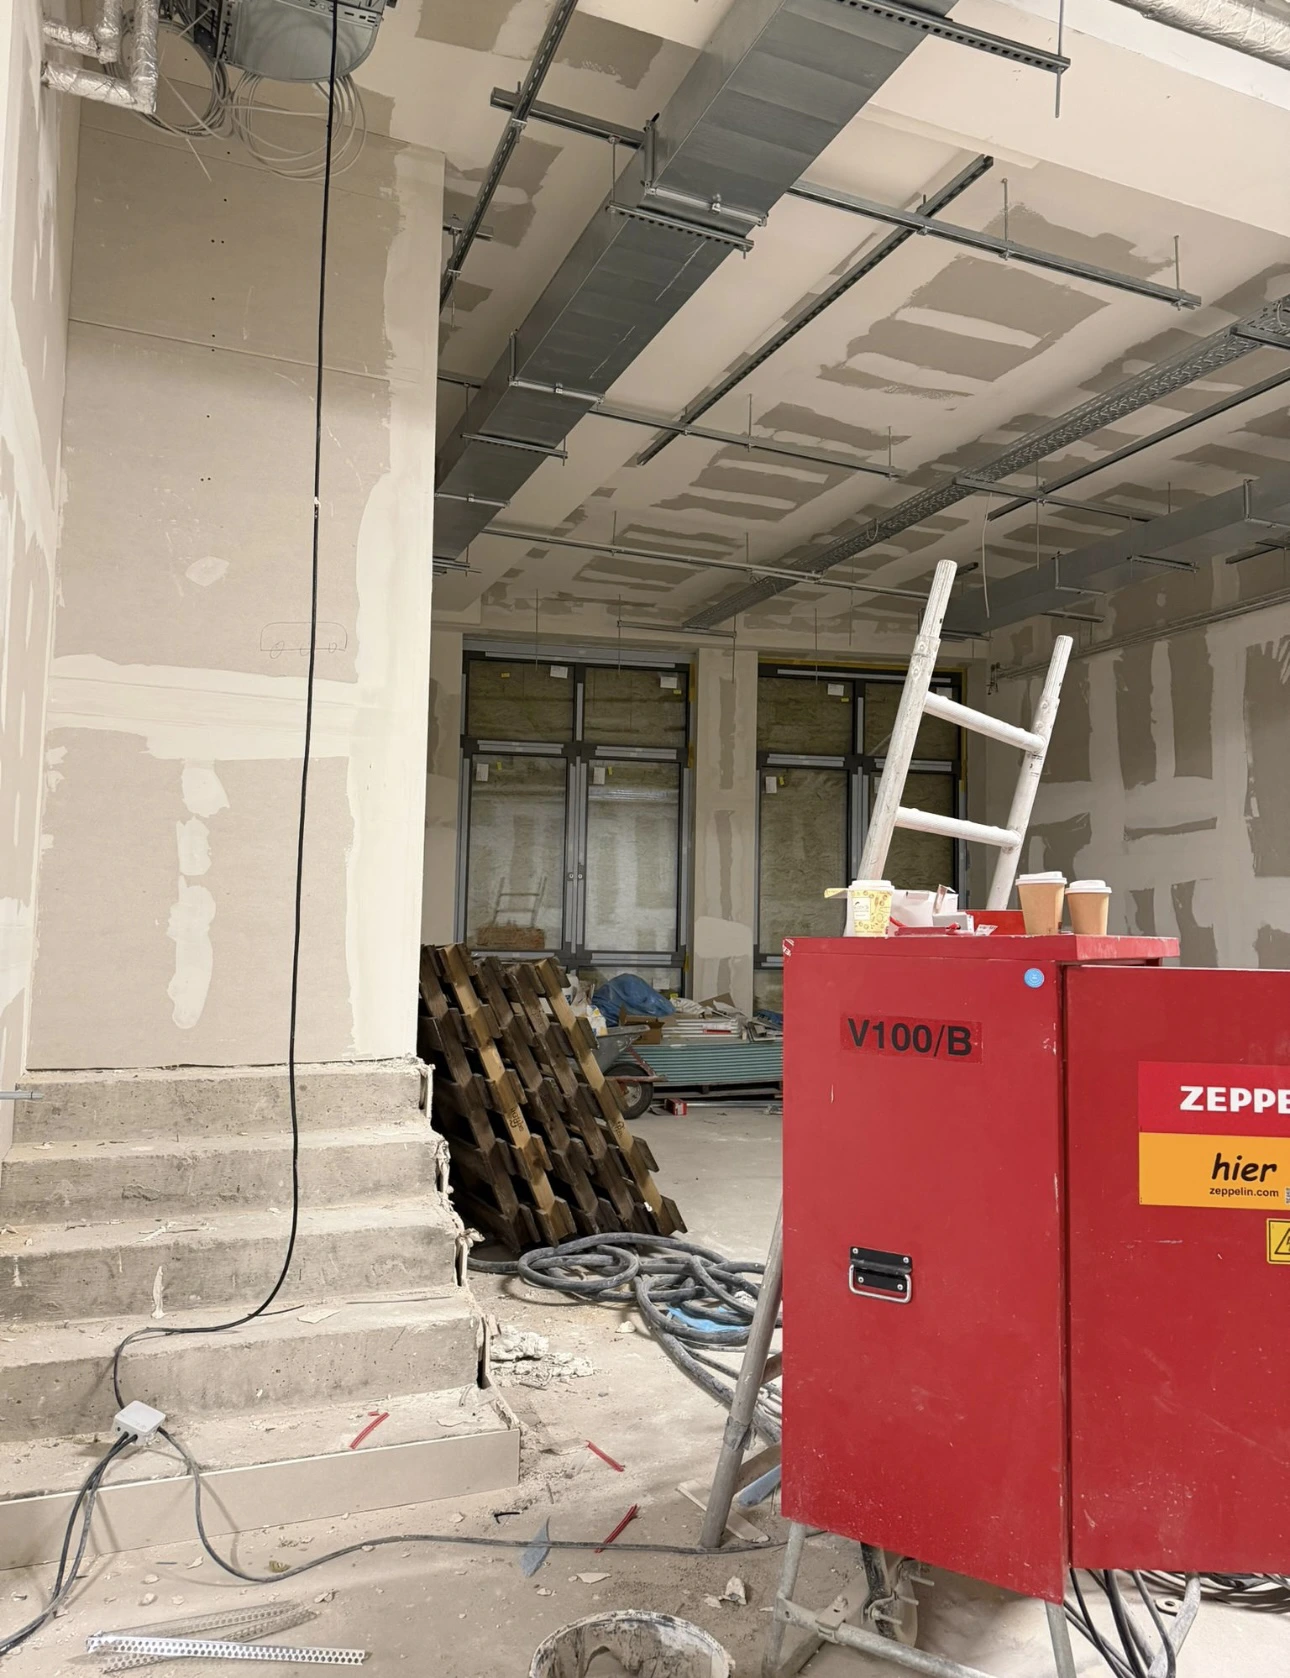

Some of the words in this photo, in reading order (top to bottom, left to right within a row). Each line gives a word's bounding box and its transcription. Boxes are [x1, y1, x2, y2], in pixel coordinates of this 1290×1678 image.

[848, 1018, 973, 1057] V100/B
[1211, 1152, 1277, 1183] hier
[1209, 1187, 1279, 1198] zeppelin.com
